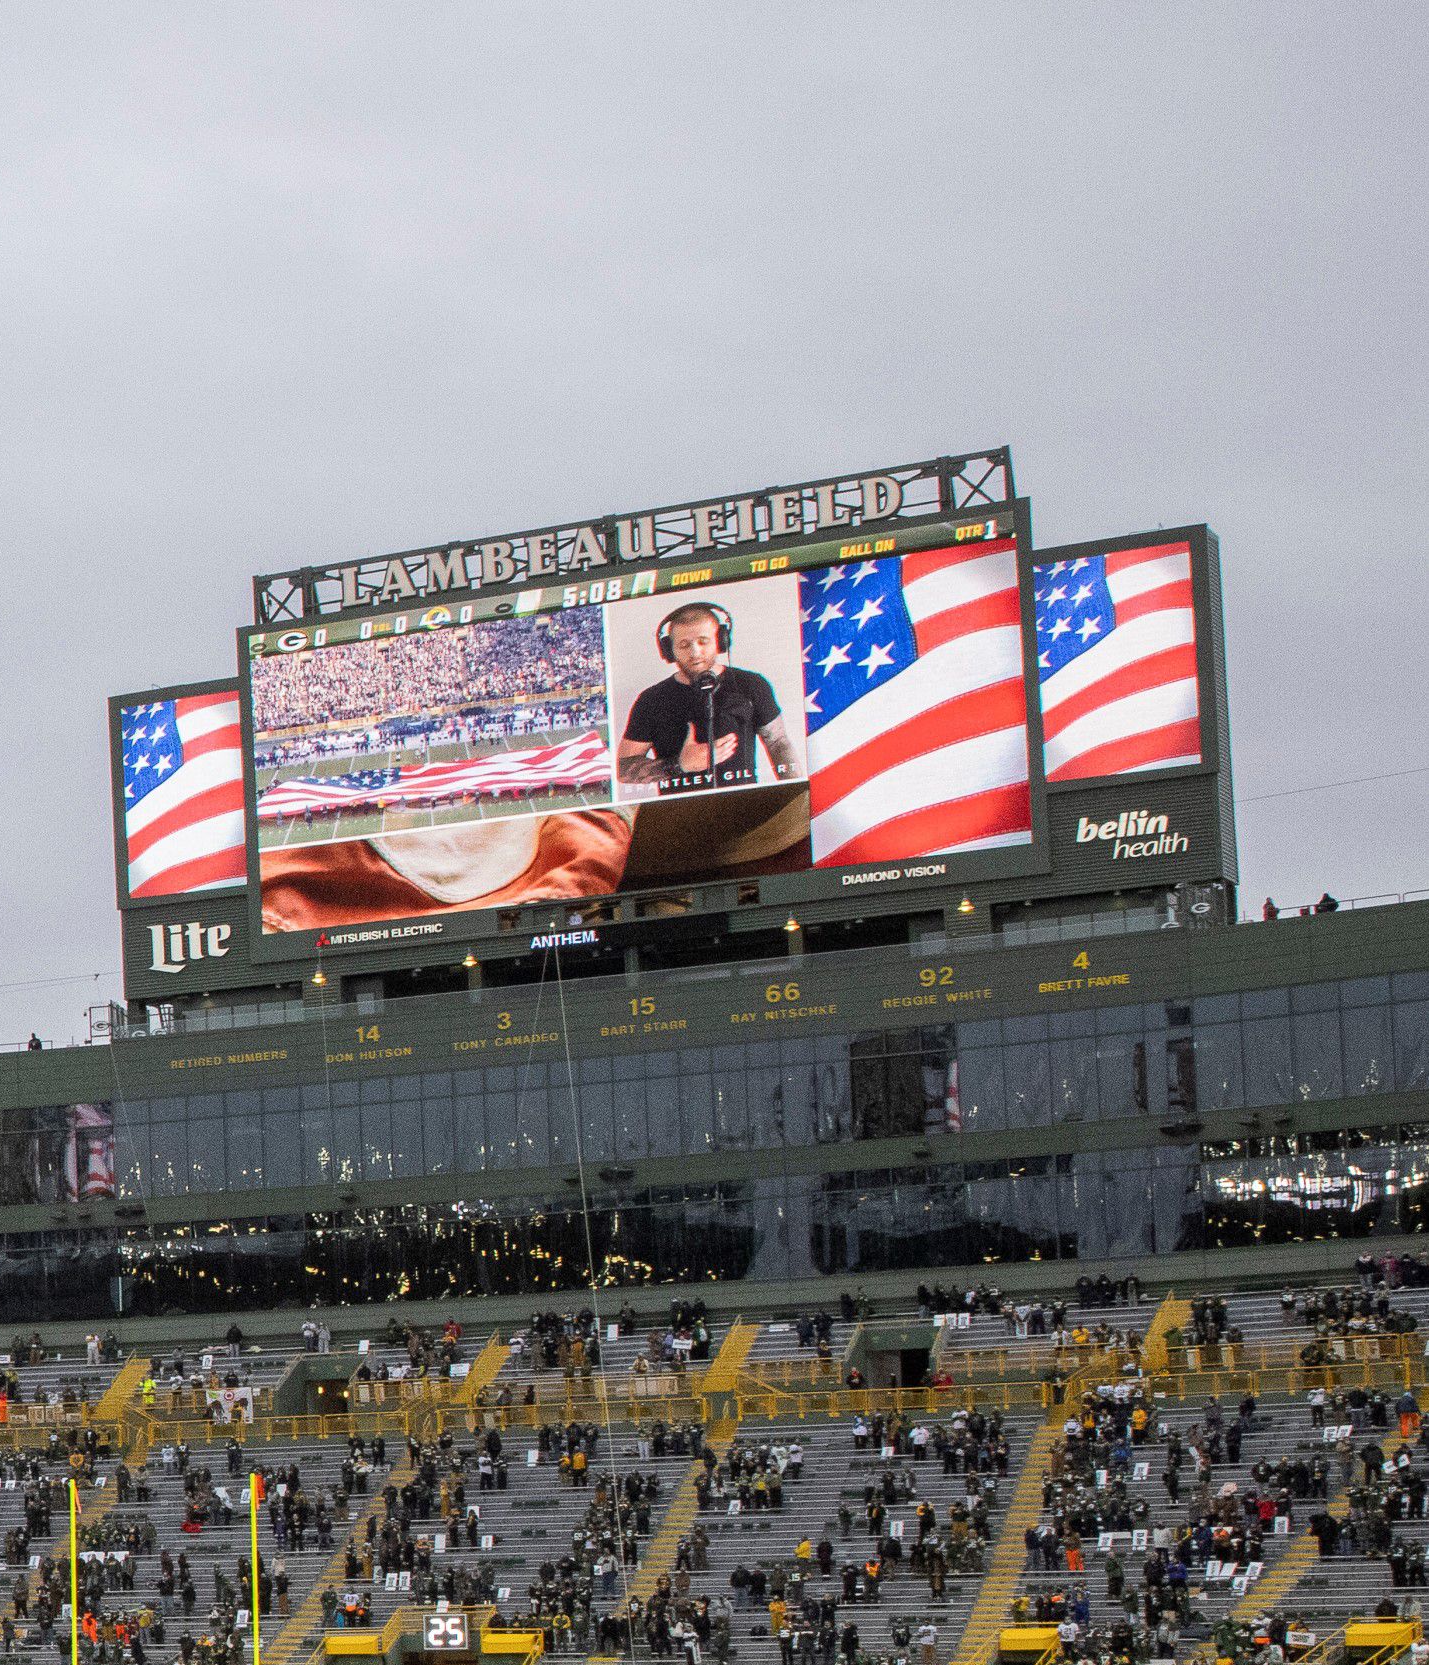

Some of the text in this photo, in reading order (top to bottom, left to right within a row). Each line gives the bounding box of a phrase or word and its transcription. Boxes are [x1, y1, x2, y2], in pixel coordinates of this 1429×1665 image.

[955, 520, 997, 541] QTR 1
[340, 476, 904, 607] LAMBEAU FIELD
[839, 539, 895, 559] BALL ON
[750, 556, 789, 573] TO GO
[671, 568, 712, 587] DOWN
[562, 583, 621, 608] 5:08
[723, 762, 801, 782] GILRT
[1076, 810, 1169, 843] bellin
[1112, 833, 1188, 860] health
[842, 864, 946, 887] DIAMOND VISION
[330, 923, 443, 945] MITSUBISHI ELECTRIC
[530, 929, 600, 949] ANTHEM.
[147, 922, 232, 973] Lite
[1072, 952, 1091, 970] 4
[918, 967, 954, 987] 92
[1038, 973, 1130, 993] BRETT FAVRE
[764, 982, 800, 1003] 66
[882, 989, 993, 1008] REGGIE WHITE
[628, 997, 657, 1017] 15
[730, 1005, 837, 1024] RAY NITSCHKE
[496, 1012, 512, 1030] 3
[600, 1019, 687, 1038] BART STARR
[356, 1026, 380, 1043] 14
[452, 1032, 559, 1052] TONY CANADEO
[169, 1050, 287, 1070] RETIRED NUMBERS
[325, 1047, 413, 1064] DON HUTSON
[428, 1617, 466, 1647] 25
